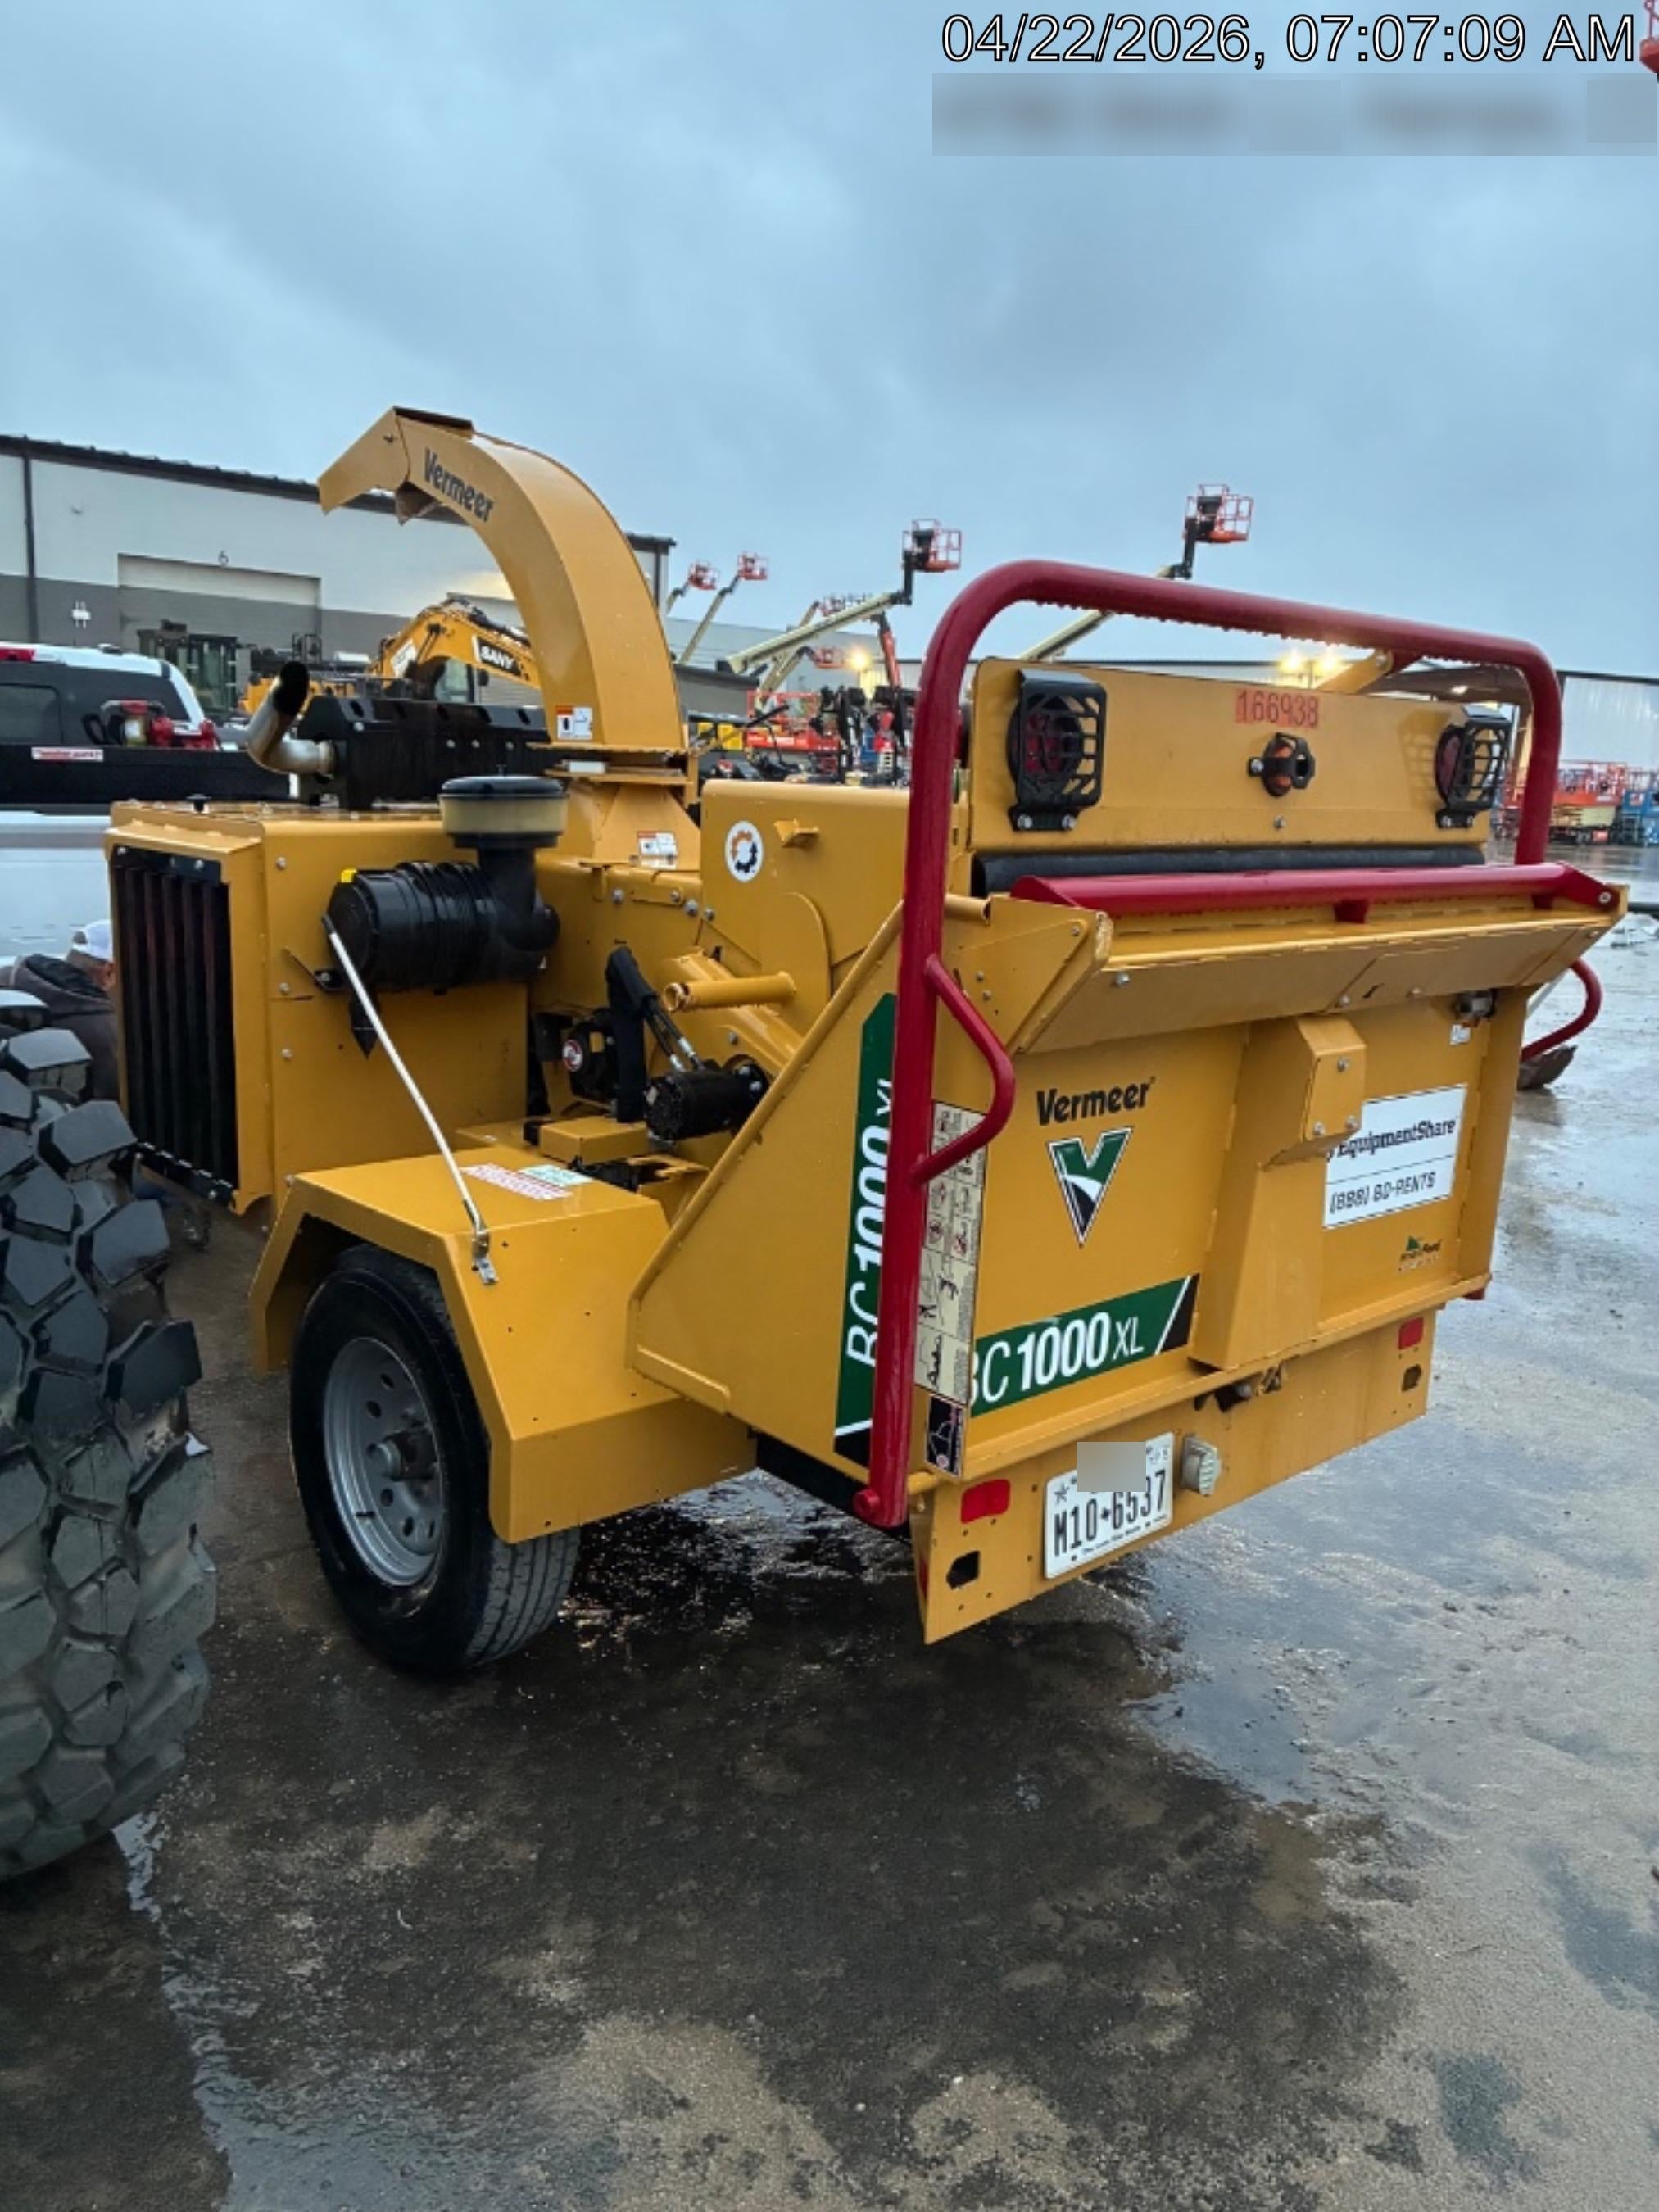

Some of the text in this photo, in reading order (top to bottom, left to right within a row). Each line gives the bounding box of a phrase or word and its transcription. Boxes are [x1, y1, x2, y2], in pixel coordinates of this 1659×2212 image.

[425, 448, 494, 522] Vermeer
[480, 645, 515, 670] SANY
[1237, 689, 1318, 728] 166938
[1036, 1081, 1151, 1126] Vermeer
